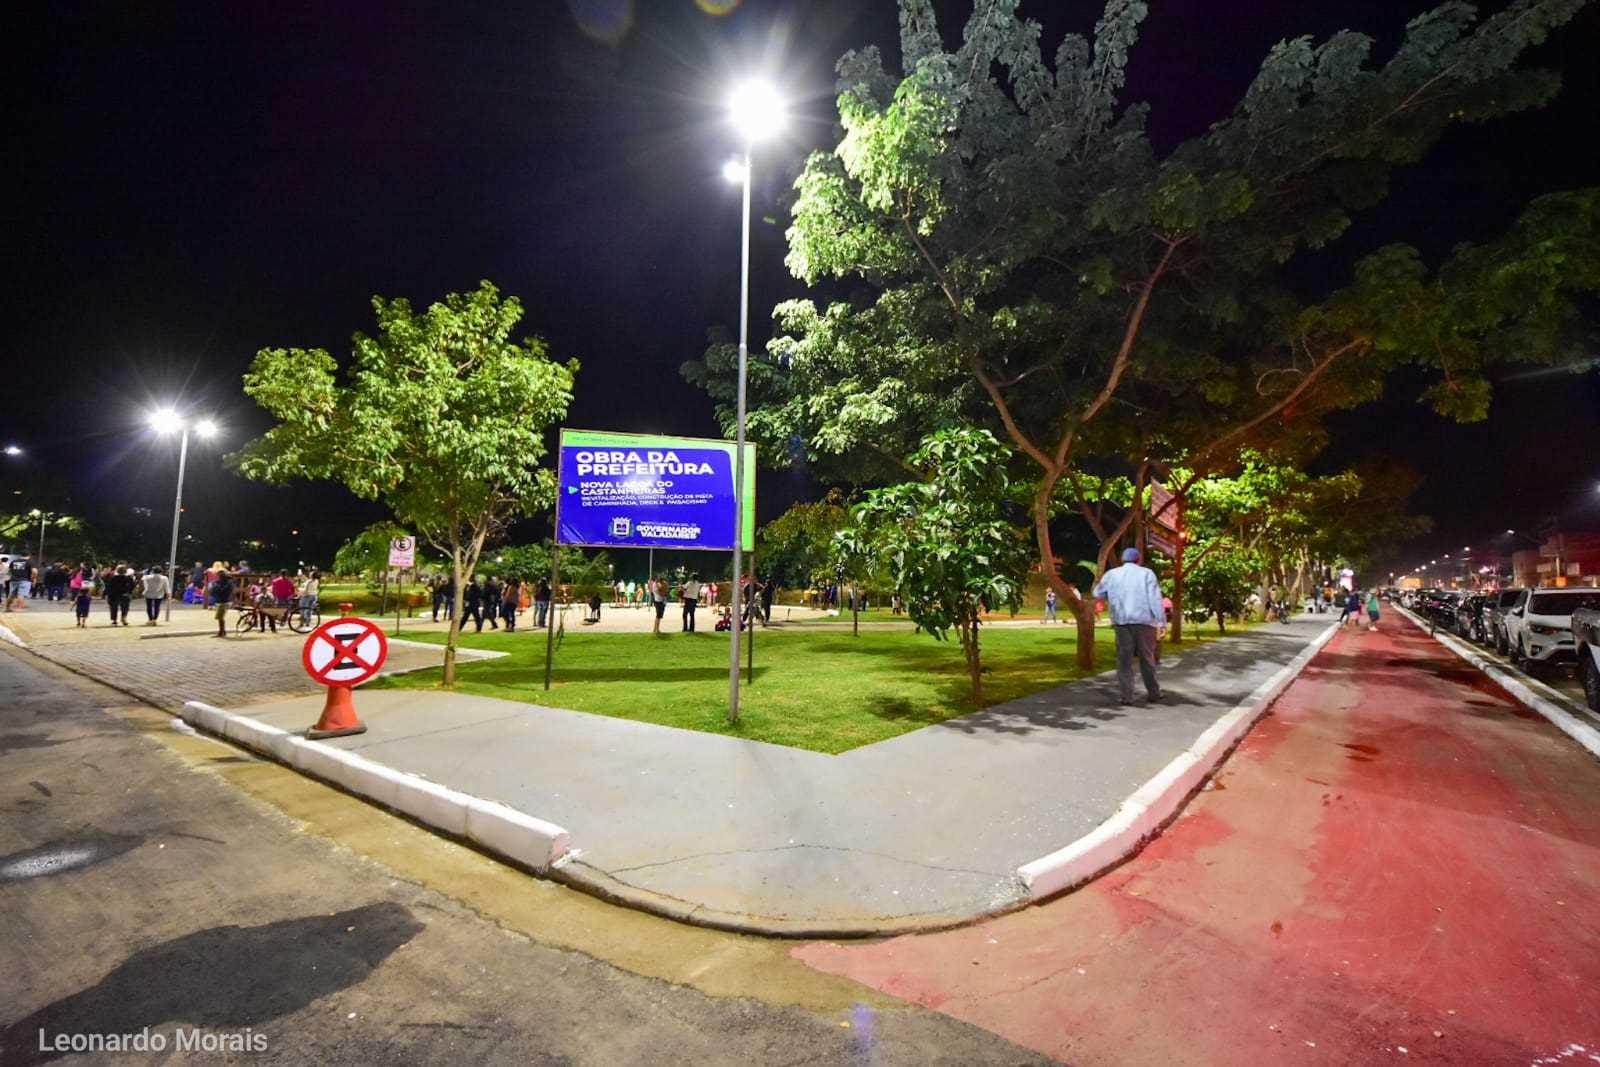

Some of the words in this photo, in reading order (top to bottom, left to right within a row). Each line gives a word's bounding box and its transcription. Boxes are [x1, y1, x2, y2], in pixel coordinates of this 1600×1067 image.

[576, 451, 642, 464] OBRA
[647, 451, 680, 463] DA
[577, 463, 714, 476] PREFEITURA
[580, 481, 613, 489] NOVA
[581, 487, 666, 496] CASTANHEIRAS
[636, 524, 701, 534] GOVERNADOR
[641, 530, 697, 539] VALADARES
